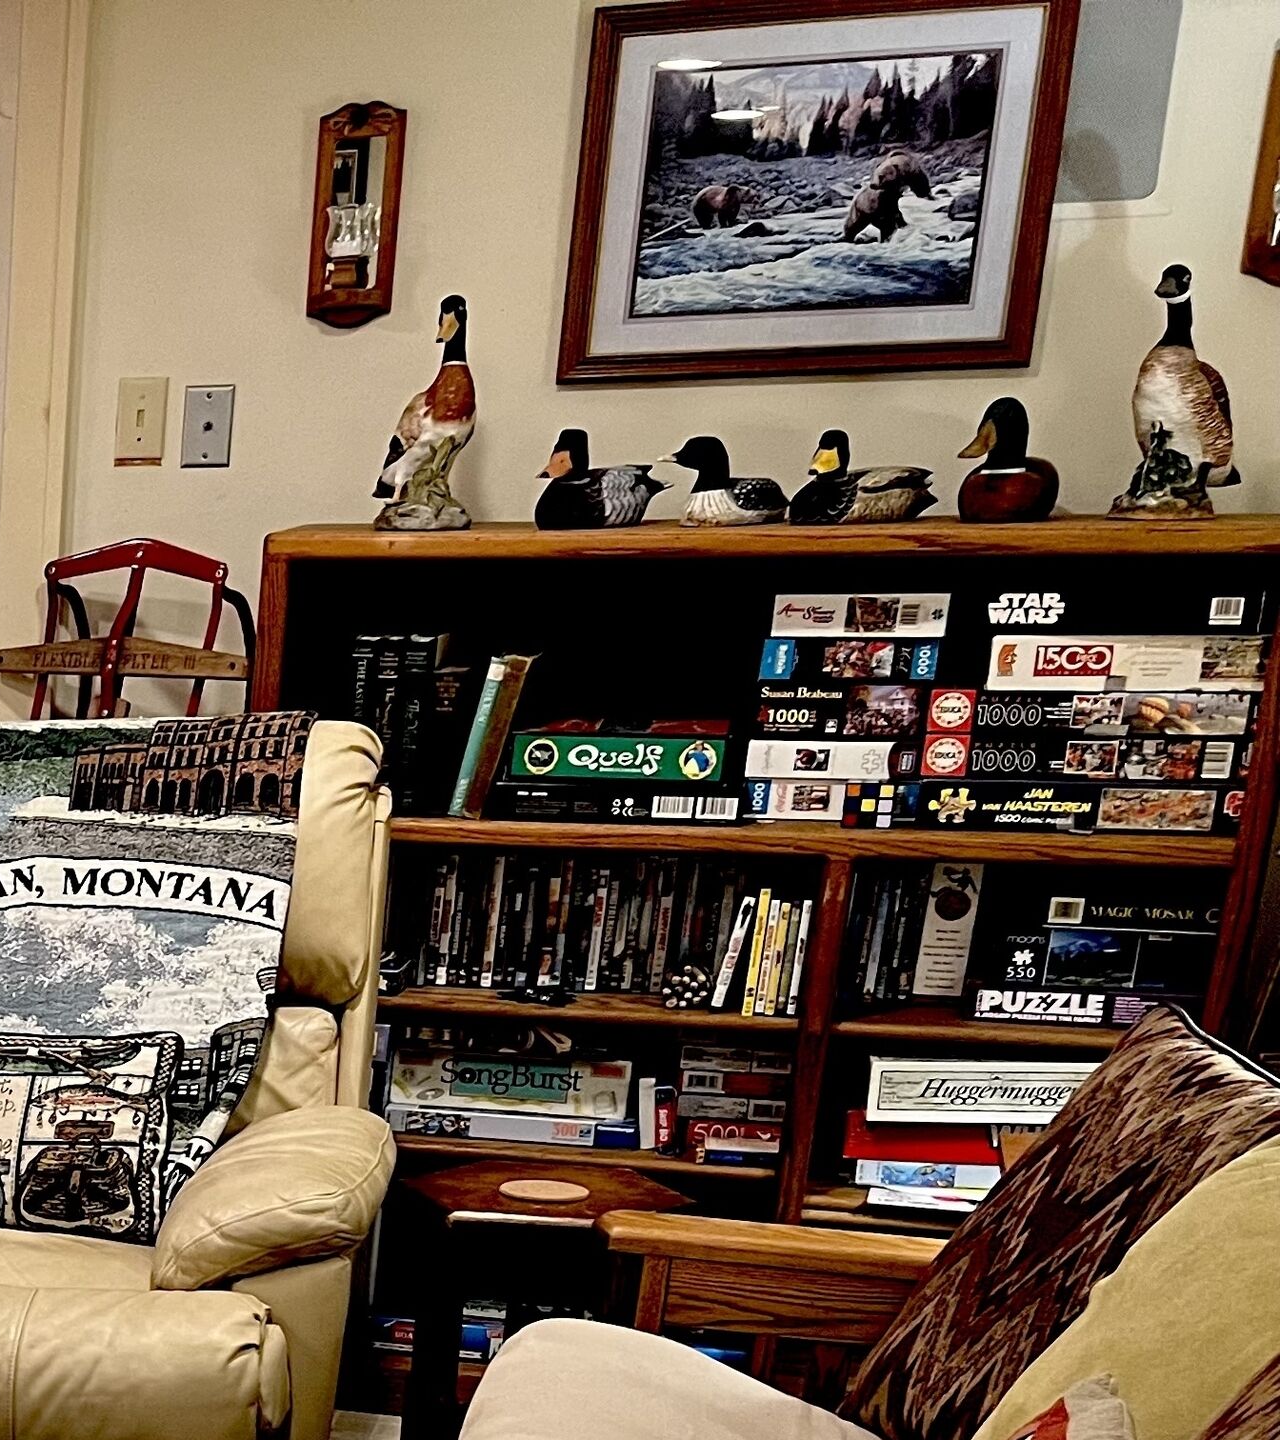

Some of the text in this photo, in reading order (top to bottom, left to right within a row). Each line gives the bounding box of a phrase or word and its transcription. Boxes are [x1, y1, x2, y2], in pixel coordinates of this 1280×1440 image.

[987, 592, 1066, 609] STAR
[987, 607, 1065, 624] WARS
[916, 644, 931, 676] 1000
[1037, 646, 1112, 671] 1500
[760, 686, 843, 699] Susan Brabeau
[766, 708, 810, 723] 1000
[977, 703, 1042, 726] 1000
[567, 743, 664, 776] Quelf
[972, 749, 1036, 772] 1000
[752, 782, 766, 811] 1000
[1023, 788, 1054, 799] JAN
[1003, 801, 1092, 813] HAASTEREN
[994, 814, 1022, 823] 1500
[62, 867, 278, 922] MONTANA
[1091, 906, 1138, 919] MAGIC
[1006, 966, 1036, 978] 550
[982, 989, 1106, 1016] PUZZLE
[439, 1057, 584, 1096] SongBurst
